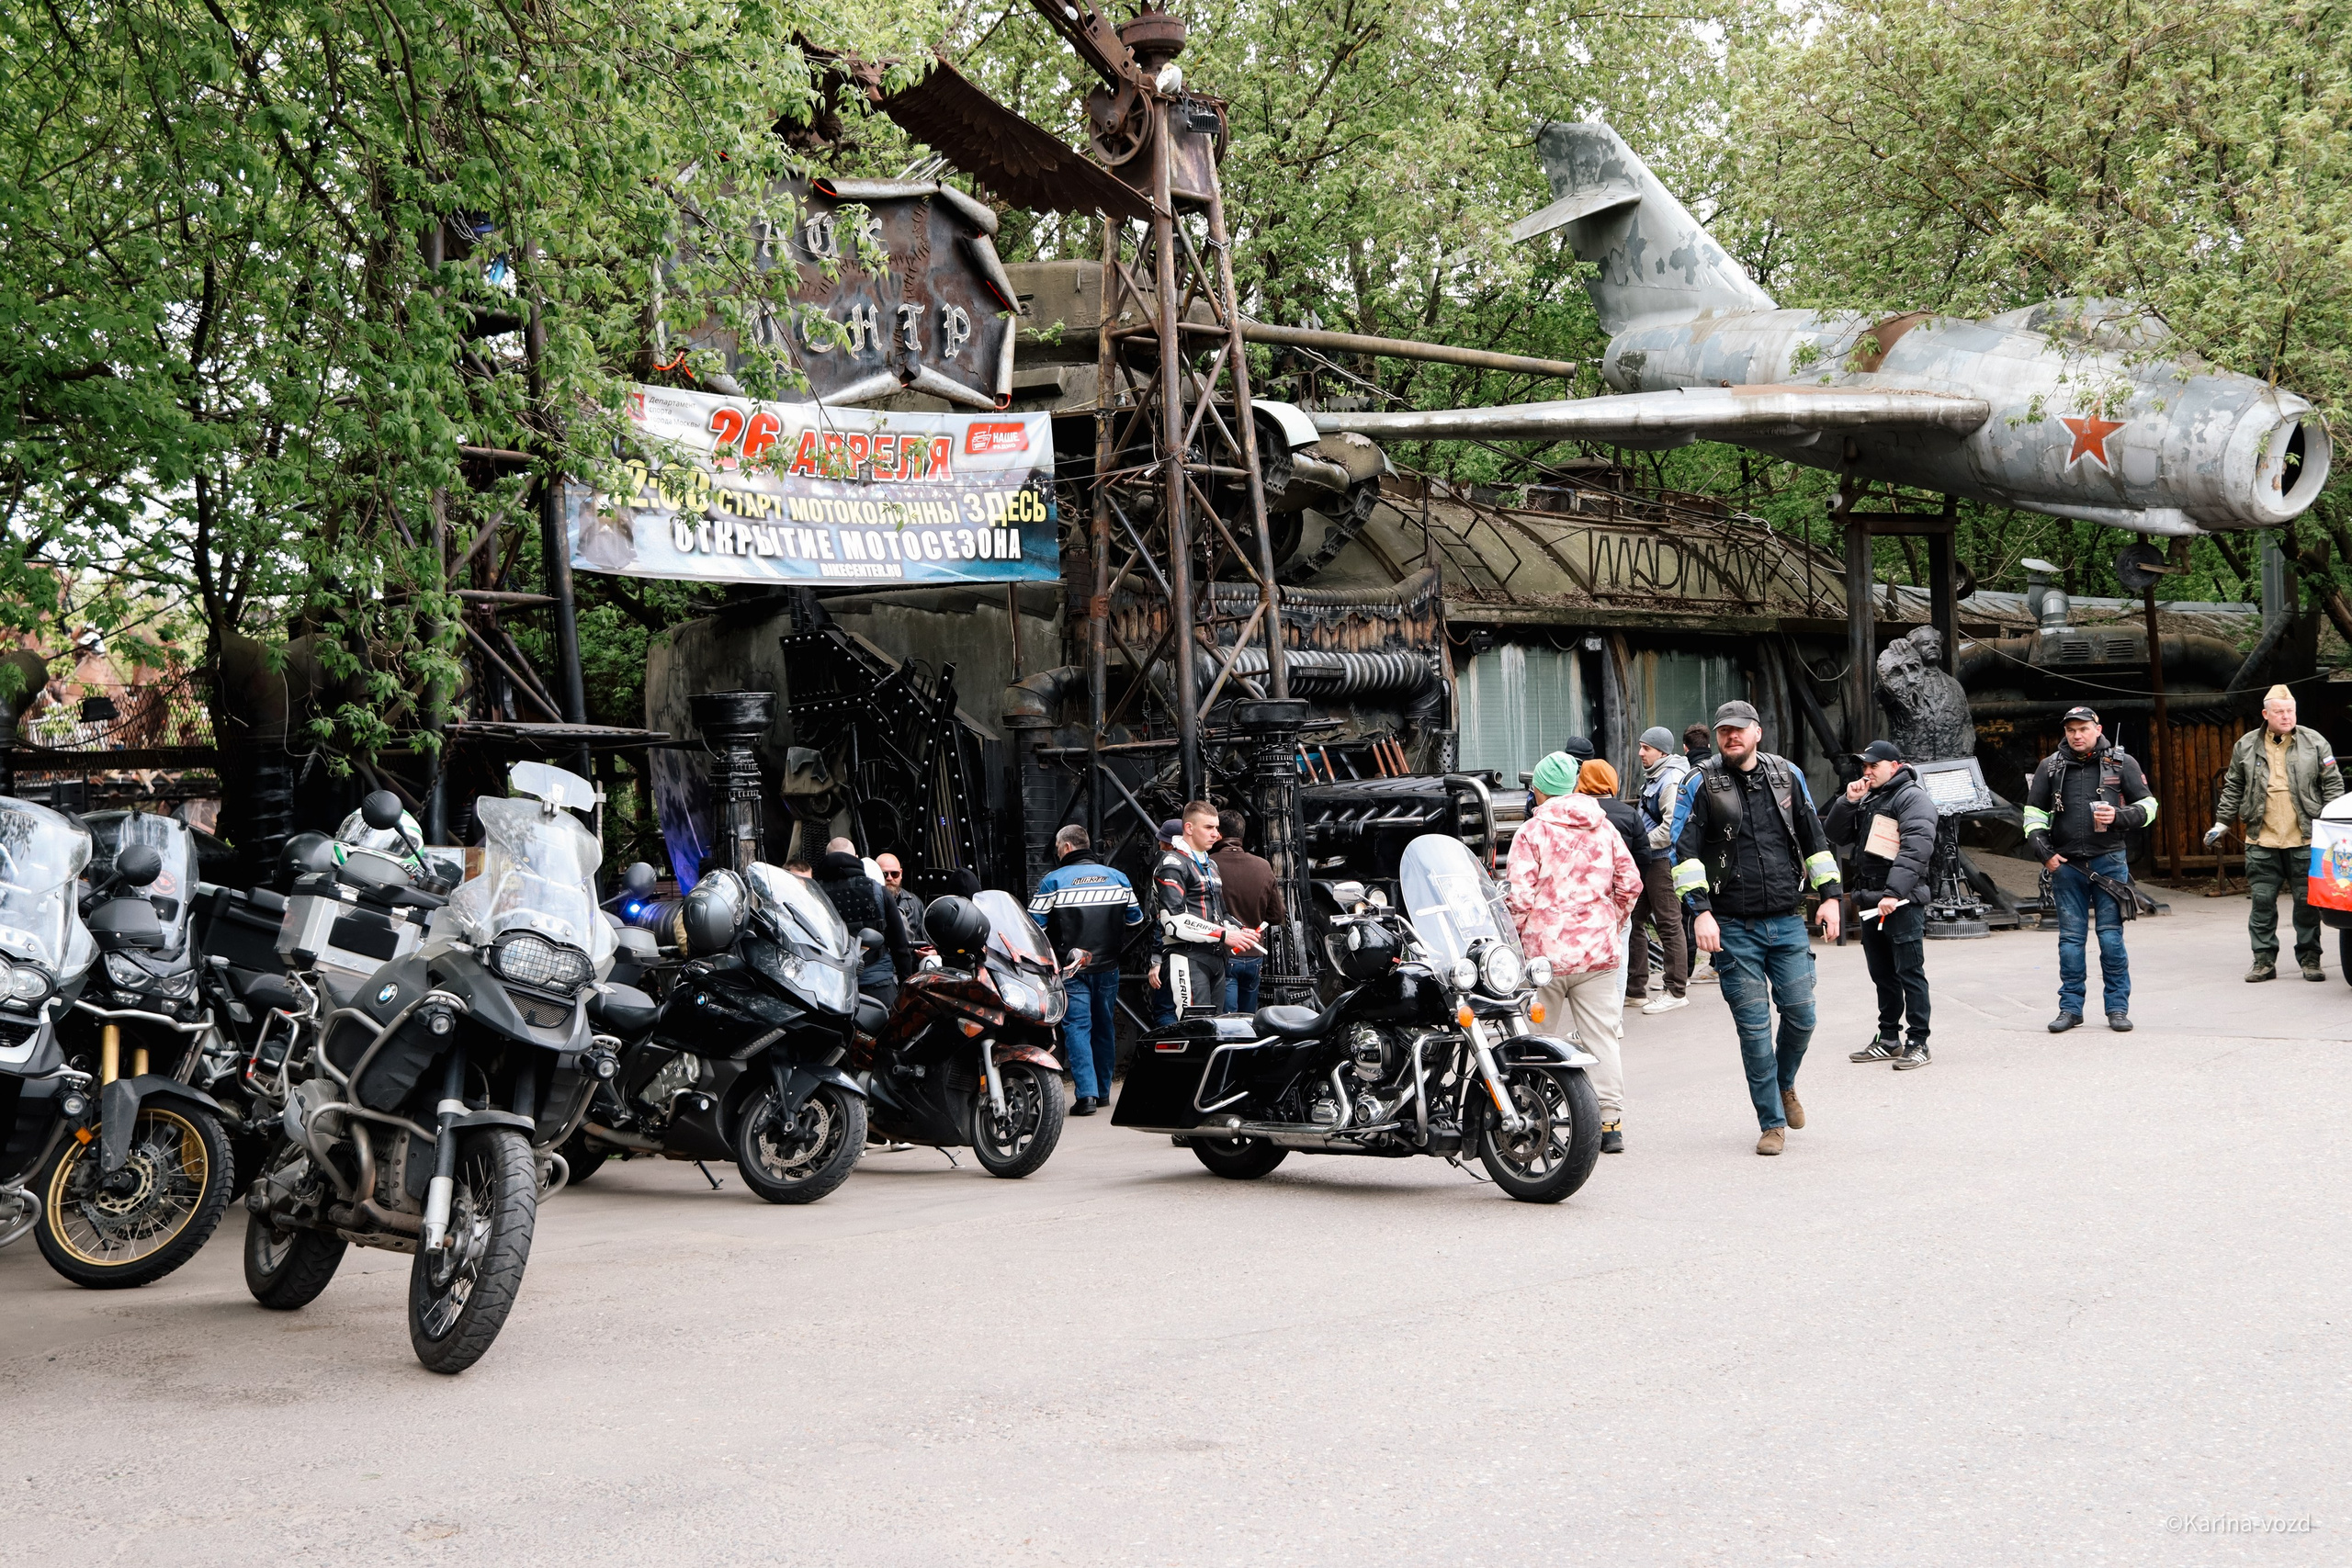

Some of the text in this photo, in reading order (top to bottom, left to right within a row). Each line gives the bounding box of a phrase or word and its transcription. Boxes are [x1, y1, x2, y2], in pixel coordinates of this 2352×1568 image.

[649, 396, 695, 409] Департамент
[649, 406, 673, 415] спорта
[673, 418, 701, 428] Москвы
[709, 406, 953, 482] 26 АПРЕЛЯ
[993, 432, 1020, 443] НАШЕ
[718, 488, 782, 520] СТАРТ
[788, 497, 961, 525] МОТОКОЛОННЫ
[965, 491, 1047, 526] ЗДЕСЬ
[674, 519, 1022, 561] ОТКРЫТИЕ МОТОСЕЗОНА
[820, 562, 903, 577] BIKECENTER.RU
[1183, 919, 1217, 931] BERING
